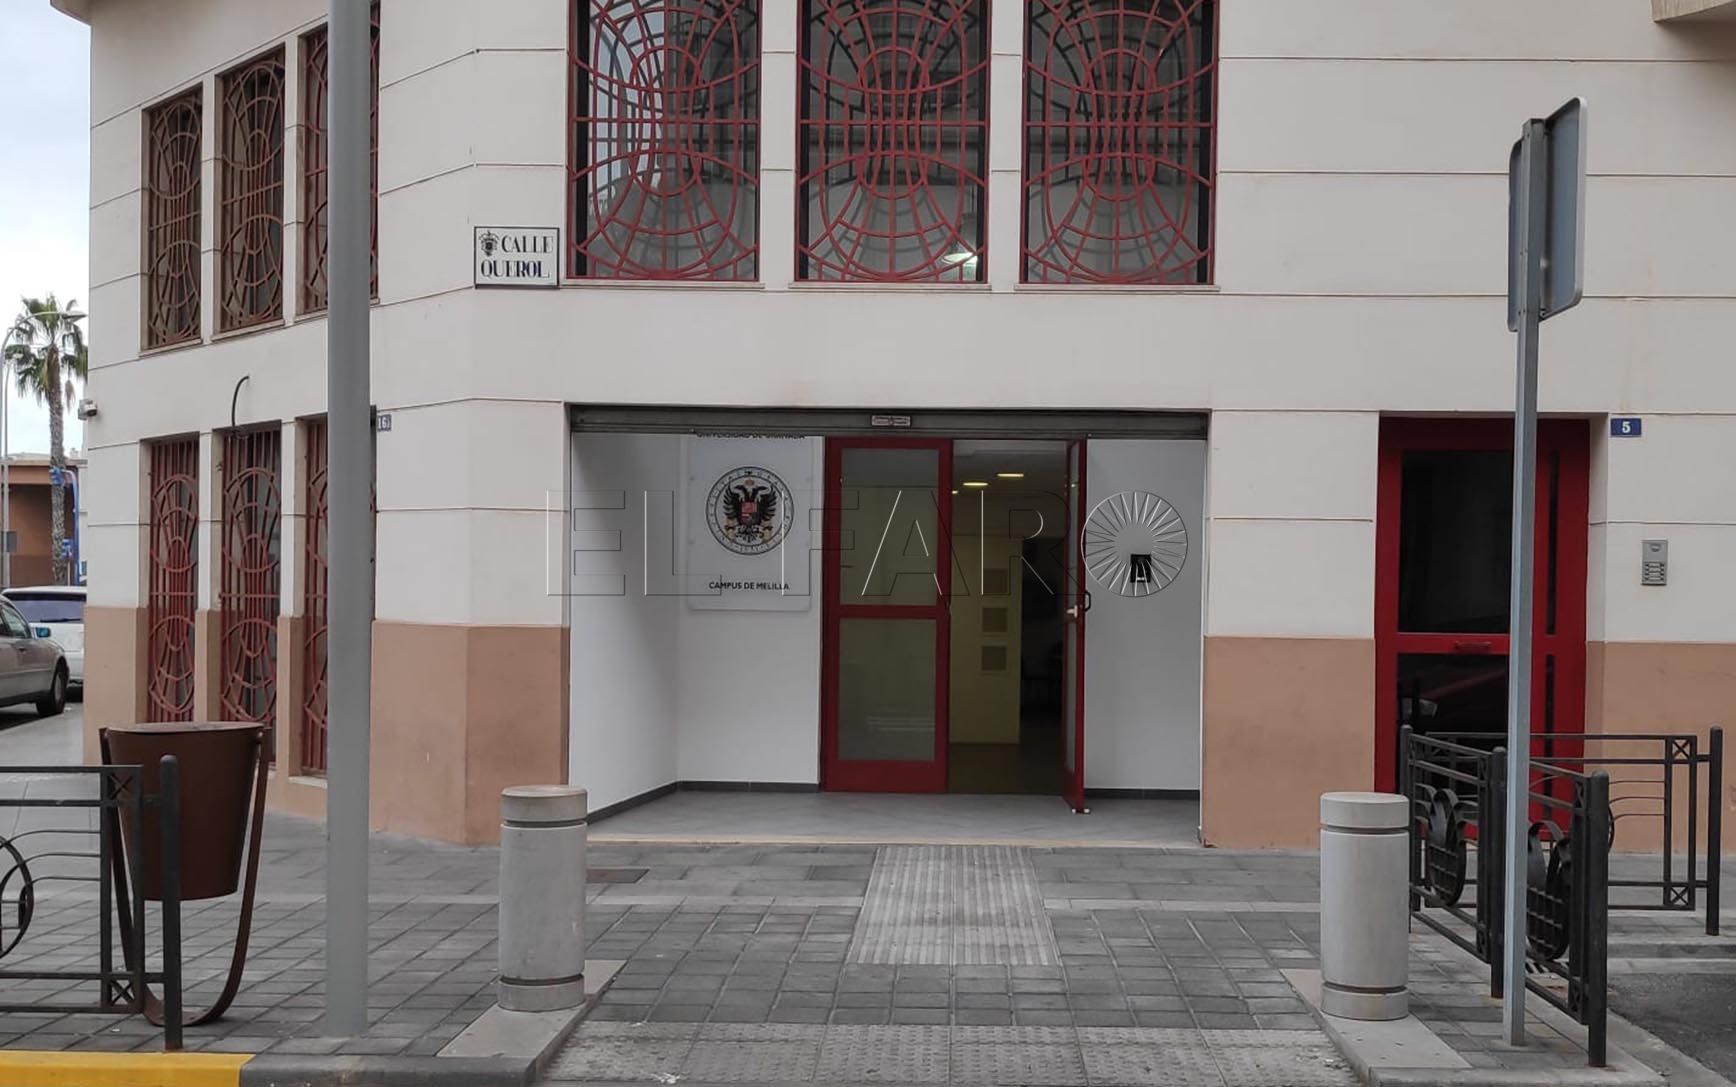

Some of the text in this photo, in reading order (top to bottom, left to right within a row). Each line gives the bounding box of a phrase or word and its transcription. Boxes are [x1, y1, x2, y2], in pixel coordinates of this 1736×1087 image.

[501, 235, 553, 253] CALLE
[480, 260, 551, 279] QUEROL
[1622, 421, 1631, 433] 5
[743, 582, 755, 590] DE
[756, 582, 789, 590] MELILLA
